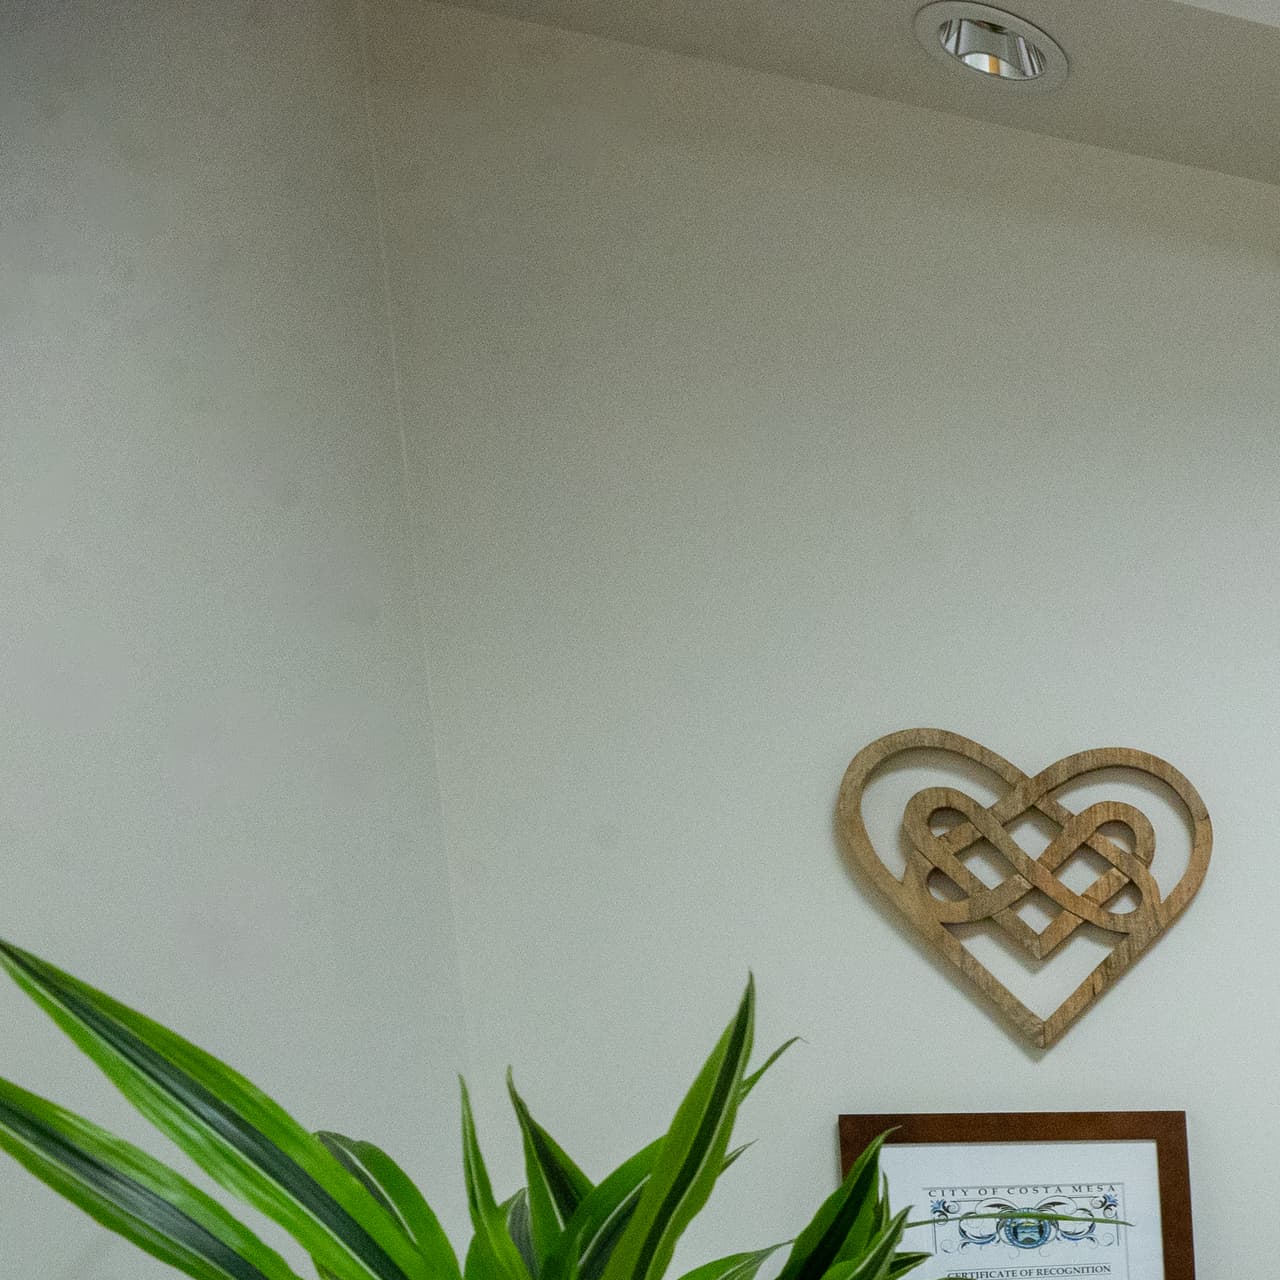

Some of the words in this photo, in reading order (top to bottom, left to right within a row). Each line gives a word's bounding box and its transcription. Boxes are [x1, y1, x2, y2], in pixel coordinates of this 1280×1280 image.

[928, 1188, 969, 1198] CITY
[978, 1187, 999, 1196] OF
[1007, 1185, 1063, 1195] COSTA
[1072, 1184, 1117, 1193] MESA
[947, 1269, 1018, 1280] CERTIFICATE
[1019, 1268, 1034, 1278] OF
[1036, 1264, 1112, 1276] RECOGNITION
